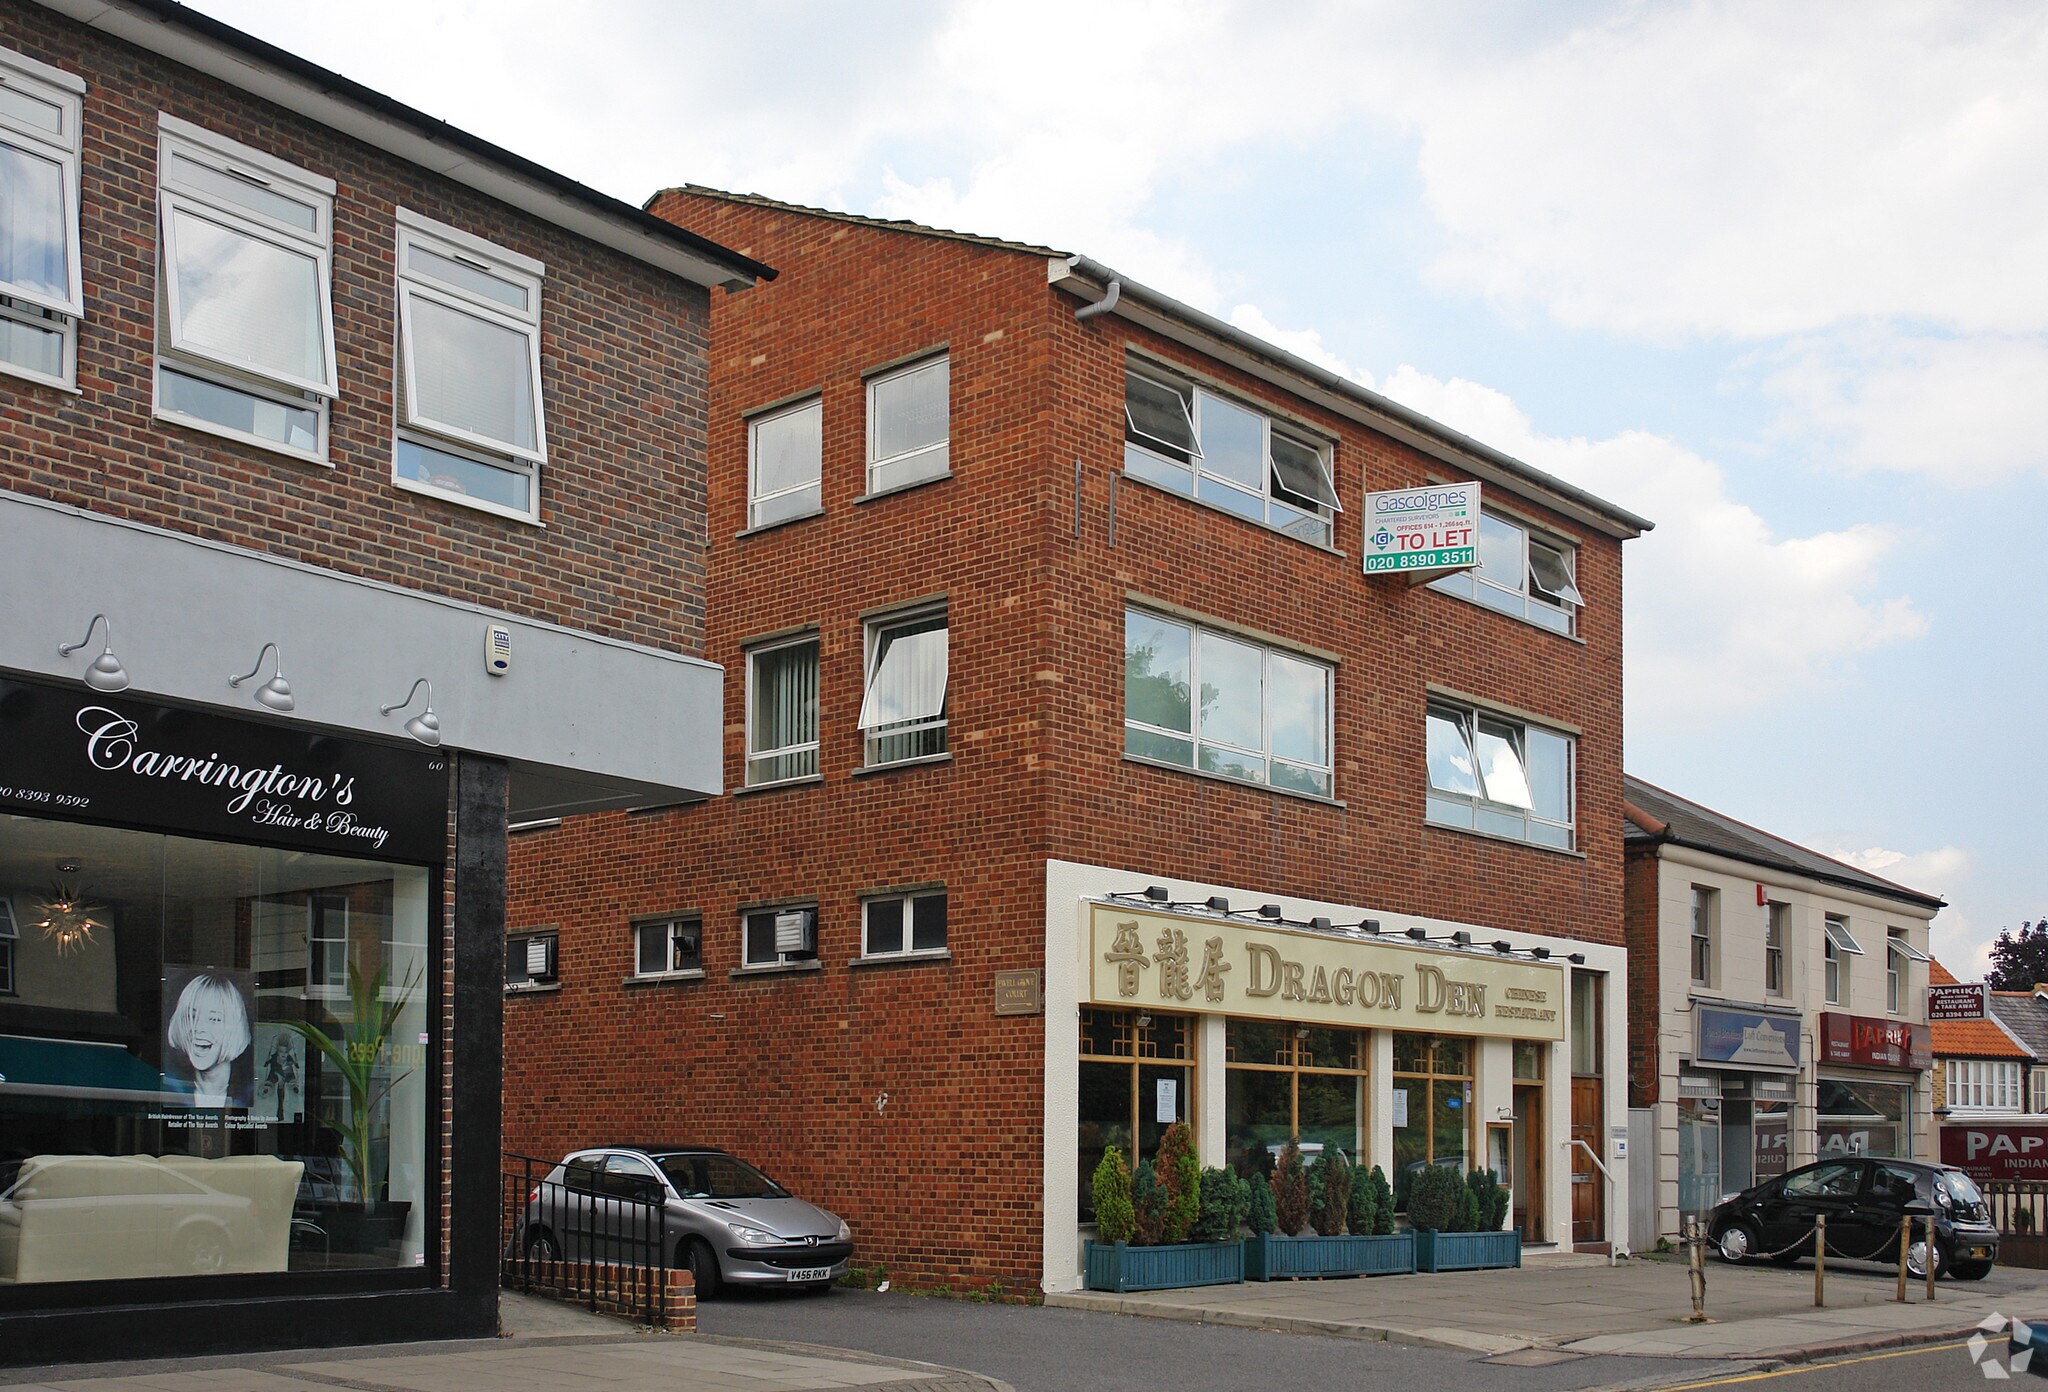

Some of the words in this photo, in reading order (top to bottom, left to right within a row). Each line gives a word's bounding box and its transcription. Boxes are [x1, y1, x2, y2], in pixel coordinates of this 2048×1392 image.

[1375, 490, 1467, 511] Gascoignes
[1375, 515, 1407, 524] CHARTERED
[1408, 513, 1440, 522] SURVEYORS
[1396, 523, 1423, 532] OFFICES
[1377, 534, 1387, 544] G
[1396, 533, 1425, 551] TO
[1433, 528, 1472, 548] LET
[1368, 557, 1395, 570] 020
[1400, 553, 1436, 567] 8390
[1441, 550, 1473, 564] 3511
[75, 705, 355, 815] Carrington's
[428, 761, 444, 771] 60
[0, 785, 13, 797] 0
[15, 788, 51, 803] 8393
[55, 794, 90, 808] 9592
[252, 798, 302, 827] Hair
[303, 812, 322, 830] &
[325, 810, 390, 849] Beauty
[1245, 941, 1404, 1011] DRAGON
[1415, 962, 1488, 1019] DEN
[1504, 986, 1548, 1003] CHINESE
[1928, 986, 1983, 998] PAPRIKA
[1494, 1004, 1557, 1022] RESTAURANT
[1967, 1131, 2048, 1161] PAP
[2004, 1159, 2048, 1168] INDIAN
[791, 1269, 812, 1279] V456
[812, 1268, 828, 1278] RKK
